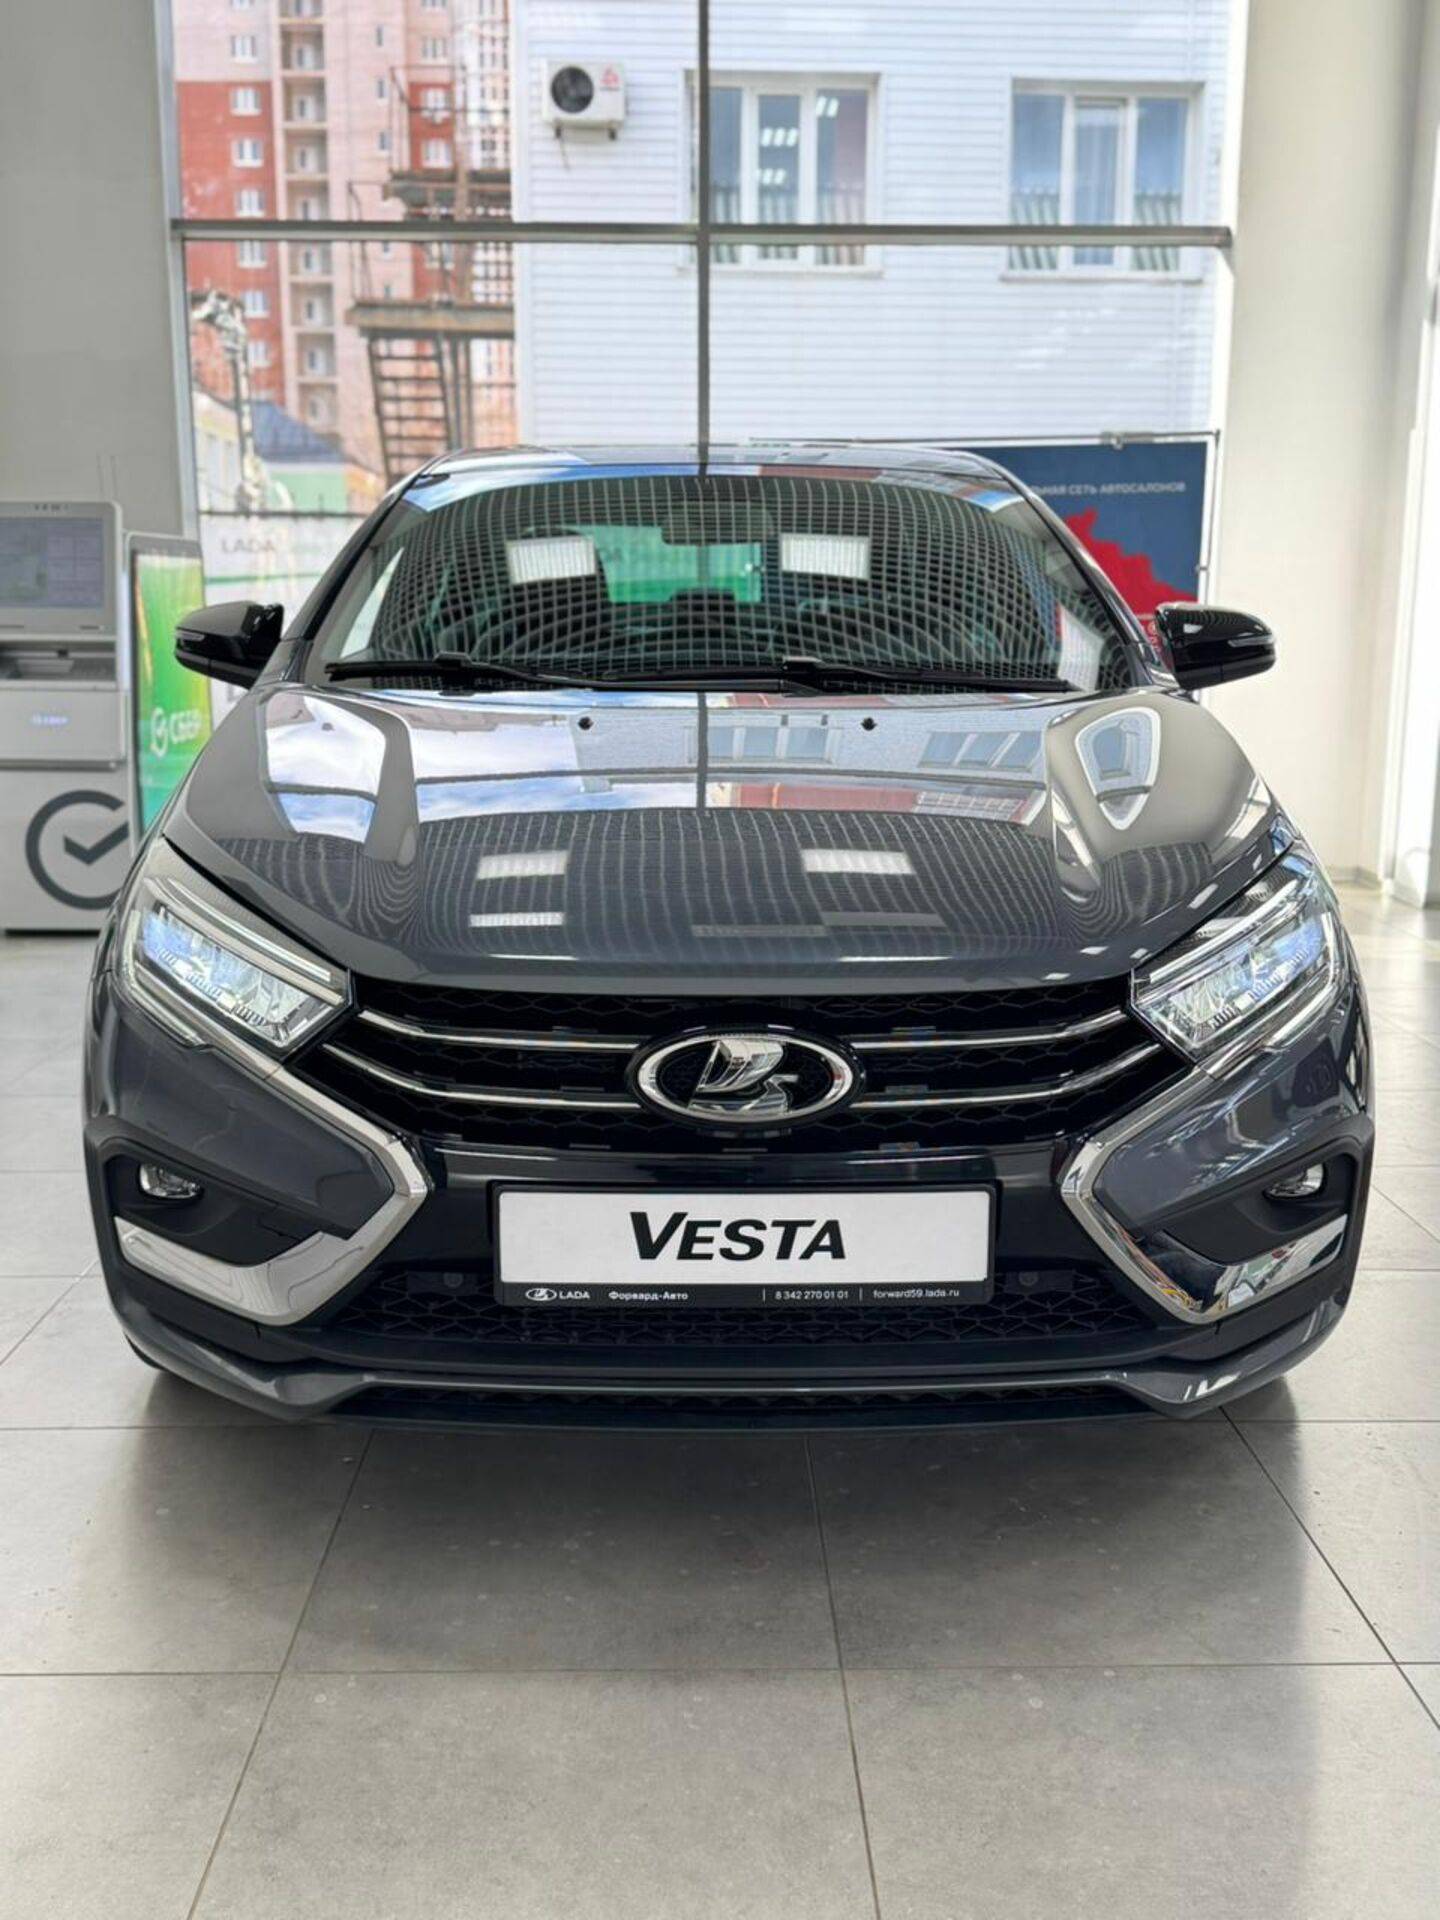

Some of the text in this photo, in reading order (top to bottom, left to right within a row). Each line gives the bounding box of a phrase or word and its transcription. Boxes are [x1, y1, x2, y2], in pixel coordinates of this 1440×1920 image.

[1068, 484, 1098, 495] СЕТЬ
[1100, 481, 1186, 495] АВТОСАЛОНОВ
[558, 1290, 591, 1300] LADA
[608, 1290, 689, 1302] Форвард-Авто
[774, 1288, 849, 1300] 8 342 270 01 01
[872, 1287, 960, 1299] forward59.lada.ru
